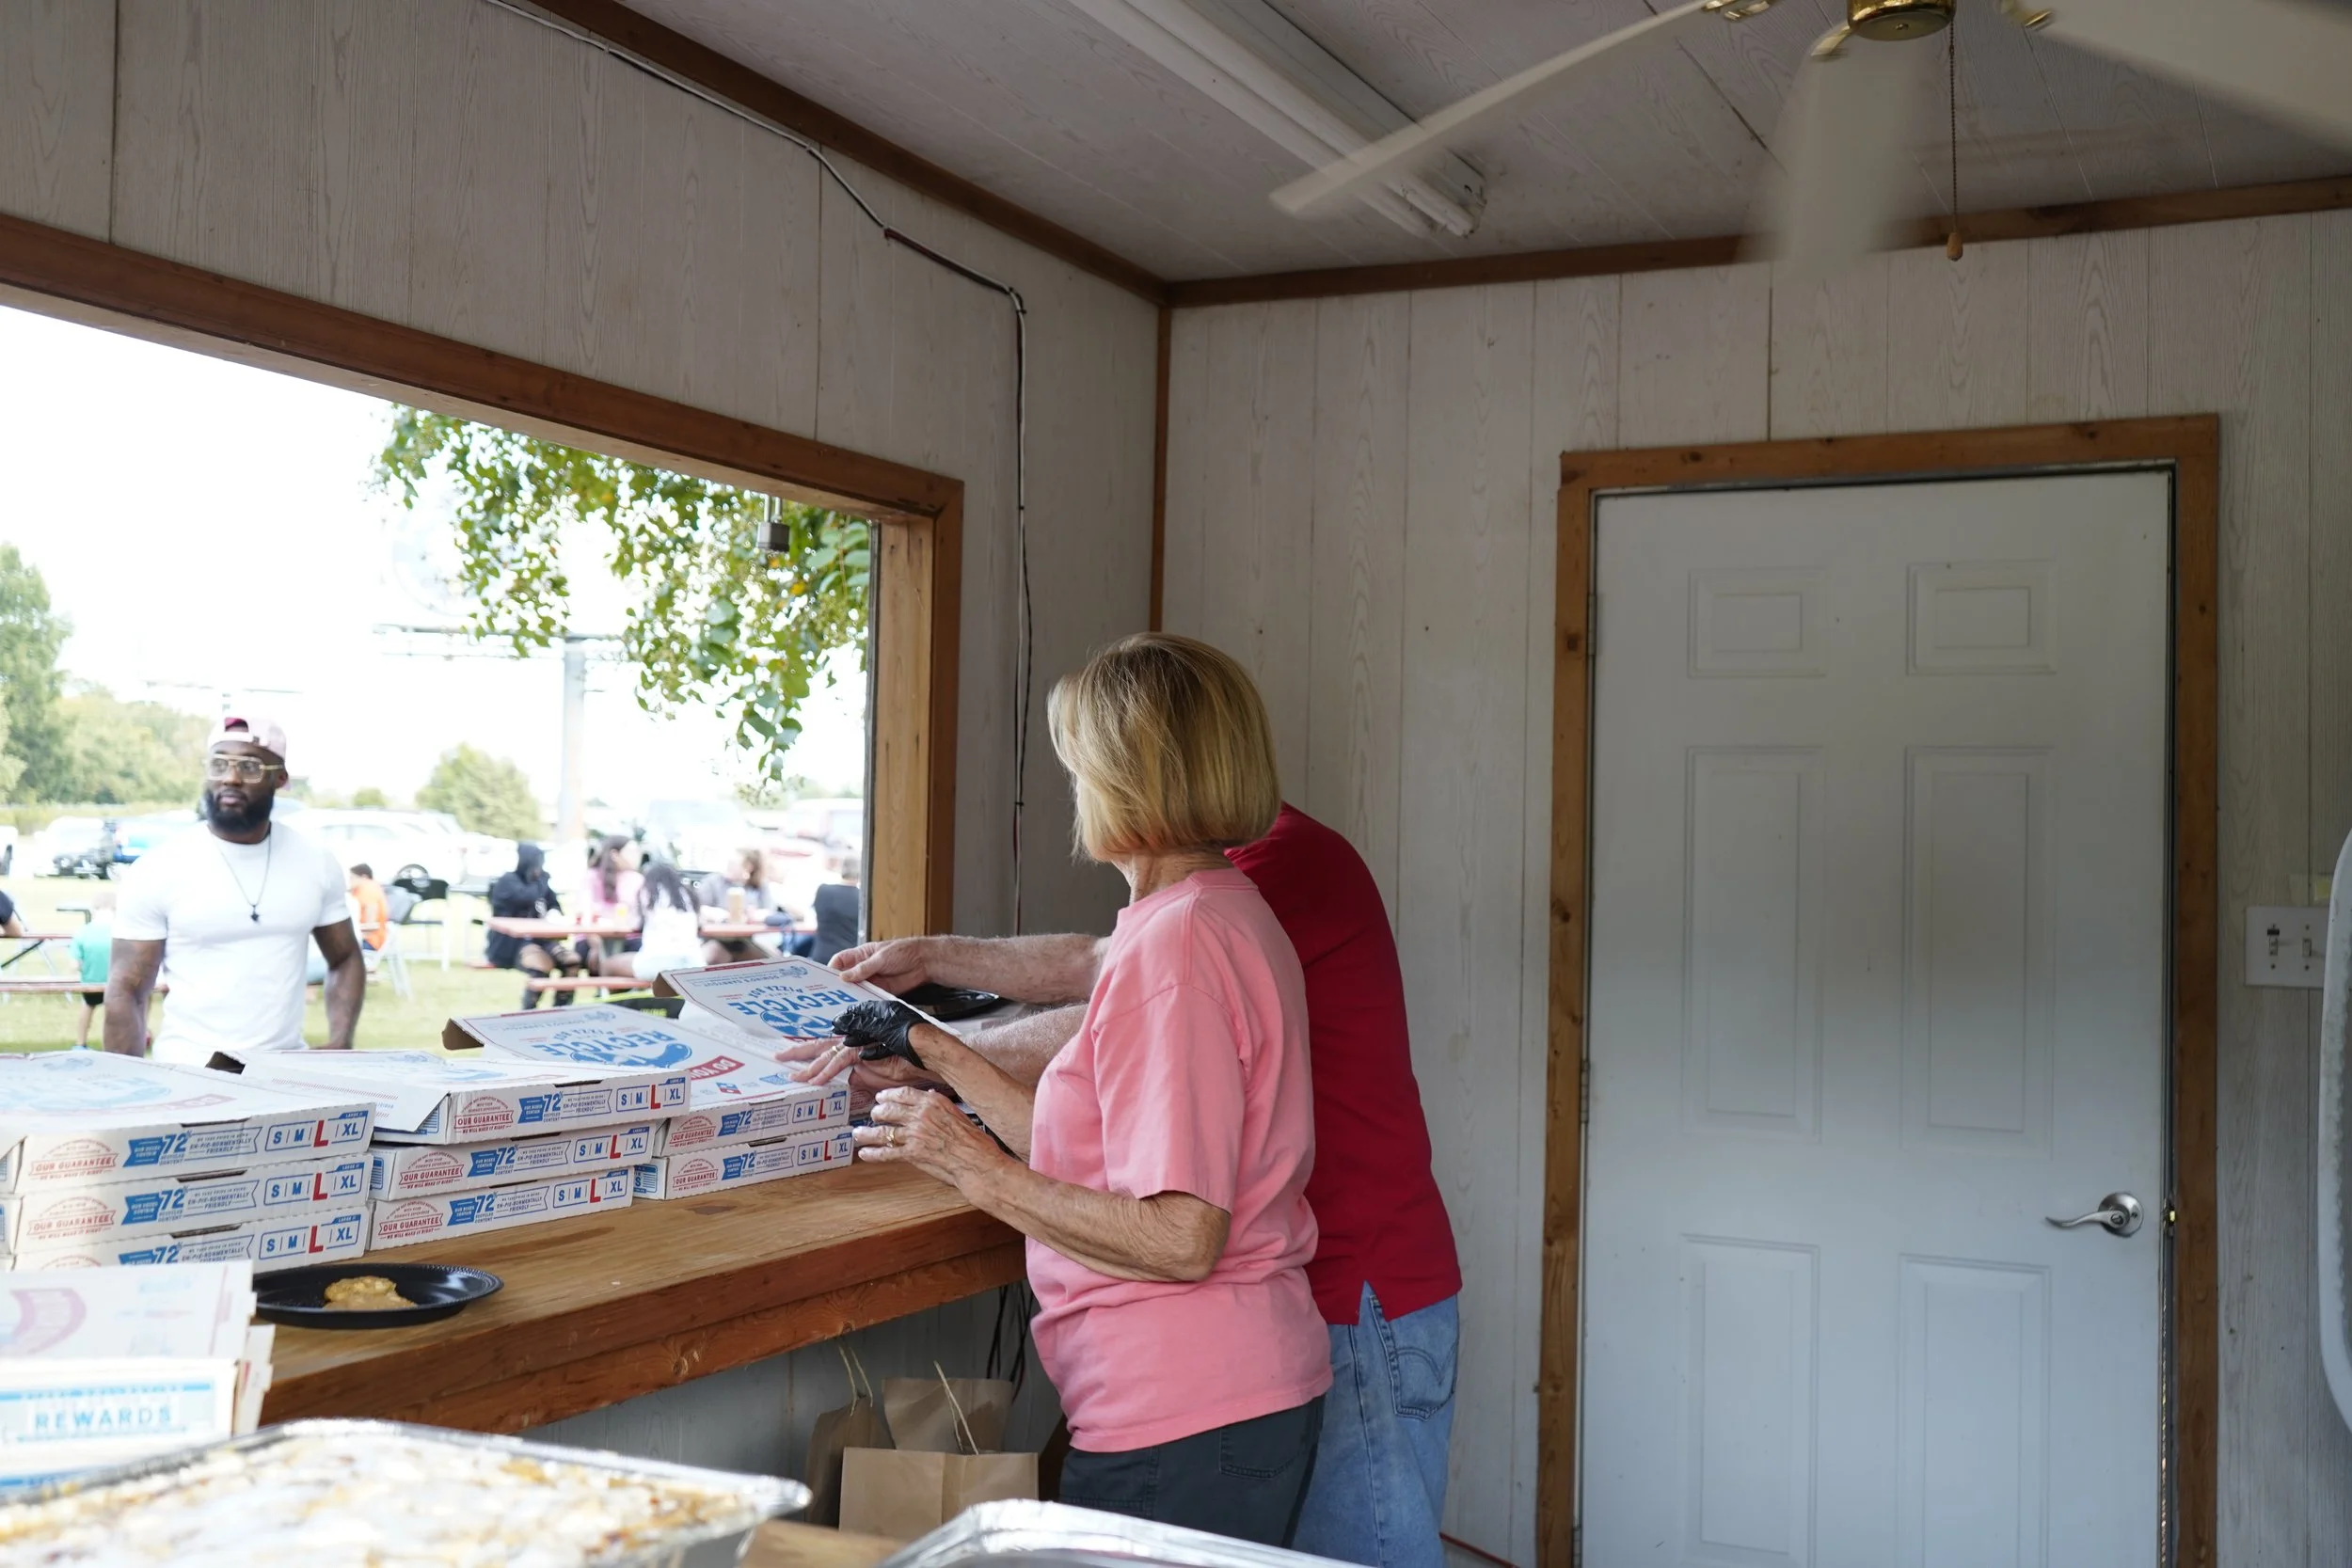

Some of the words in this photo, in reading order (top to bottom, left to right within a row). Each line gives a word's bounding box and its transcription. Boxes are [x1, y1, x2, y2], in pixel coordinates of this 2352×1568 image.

[727, 990, 859, 1016] RECYCLE
[532, 1030, 678, 1056] RECYCLE
[712, 1059, 737, 1070] DO
[621, 1094, 628, 1106] S
[636, 1092, 643, 1104] M
[651, 1085, 661, 1110] L
[670, 1088, 681, 1100] XL
[474, 1114, 510, 1124] GUARANTEE
[797, 1107, 802, 1117] S
[807, 1104, 813, 1116] M
[818, 1099, 826, 1120] L
[834, 1101, 842, 1111] XL
[273, 1132, 282, 1145] S
[294, 1128, 305, 1142] M
[313, 1119, 329, 1148] L
[342, 1123, 359, 1136] XL
[685, 1129, 712, 1139] GUARANTEE
[580, 1145, 585, 1157] S
[595, 1142, 602, 1154] M
[610, 1134, 621, 1159] L
[630, 1138, 644, 1149] XL
[802, 1149, 805, 1161] S
[813, 1148, 818, 1158] M
[824, 1140, 832, 1162] L
[839, 1142, 848, 1153] XL
[36, 1163, 55, 1172] OUR
[58, 1157, 112, 1169] GUARANTEE
[404, 1173, 418, 1181] OUR
[421, 1168, 459, 1180] GUARANTEE
[271, 1184, 280, 1197] S
[292, 1181, 303, 1196] M
[312, 1173, 327, 1201] L
[341, 1176, 357, 1189] XL
[688, 1172, 715, 1183] GUARANTEE
[559, 1189, 564, 1202] S
[574, 1187, 581, 1199] M
[589, 1178, 601, 1204] L
[611, 1181, 623, 1193] XL
[204, 1201, 231, 1210] FRIENDLY
[34, 1222, 53, 1230] OUR
[56, 1214, 109, 1227] GUARANTEE
[383, 1223, 397, 1232] OUR
[400, 1217, 438, 1228] GUARANTEE
[266, 1238, 275, 1252] S
[288, 1236, 297, 1249] M
[309, 1226, 324, 1254] L
[336, 1227, 353, 1242] XL
[35, 1405, 172, 1430] REWARDS
